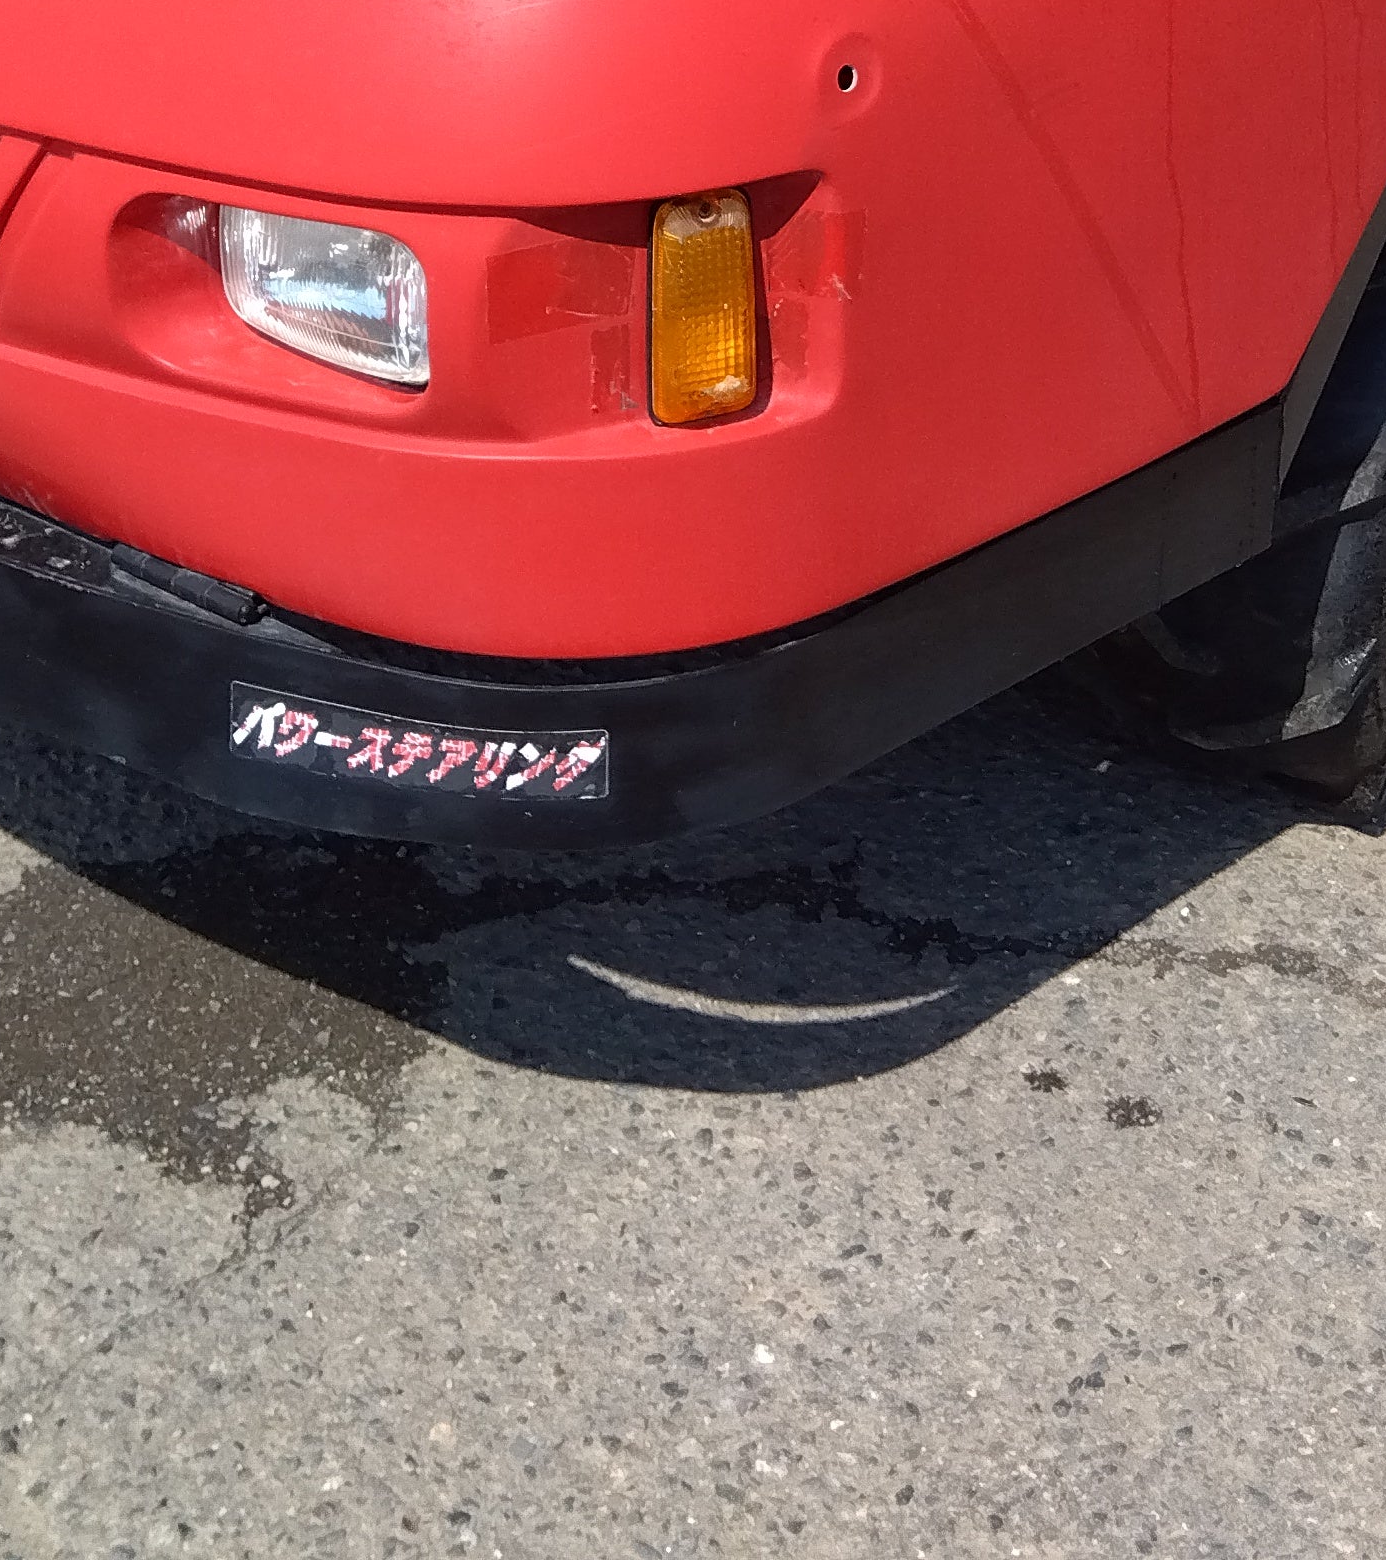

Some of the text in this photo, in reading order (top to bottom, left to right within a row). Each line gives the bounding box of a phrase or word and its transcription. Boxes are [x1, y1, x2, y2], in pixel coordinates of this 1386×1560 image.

[232, 702, 606, 792] パワーステアリング
